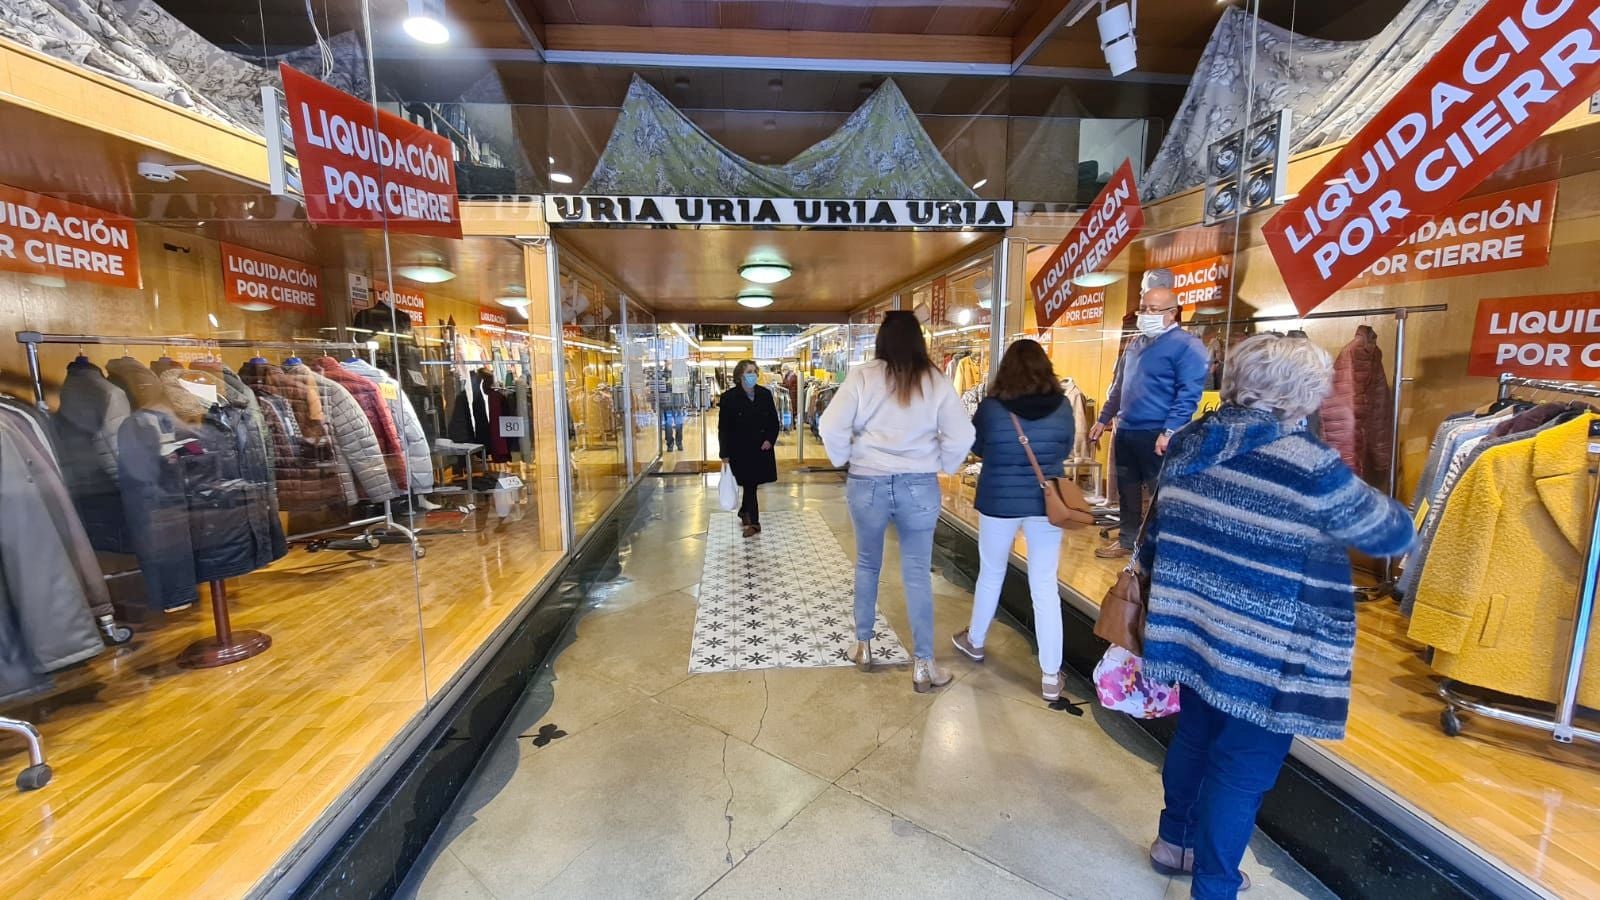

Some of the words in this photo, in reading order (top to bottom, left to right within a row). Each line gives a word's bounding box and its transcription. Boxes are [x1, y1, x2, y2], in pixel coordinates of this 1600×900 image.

[301, 102, 450, 185] LIQUIDACIÓN
[1313, 190, 1410, 280] POR
[1415, 5, 1600, 192] CIERR
[323, 165, 383, 212] POR
[385, 181, 451, 223] CIERRE
[553, 196, 664, 221] URIA
[675, 198, 780, 222] URIA
[794, 200, 897, 224] URIA
[906, 201, 1006, 224] URIA
[1036, 178, 1130, 301] LIQUIDACIÓN
[1396, 199, 1542, 247] IDACIÓN
[24, 239, 125, 276] CIERRE
[1045, 279, 1072, 320] POR
[1073, 212, 1130, 280] CIERRE
[1414, 234, 1525, 271] CIERRE
[228, 255, 318, 288] LIQUIDACIÓN
[1174, 262, 1229, 288] IDACIÓN
[236, 279, 269, 299] POR
[271, 286, 316, 306] CIERRE
[1177, 284, 1222, 306] CIERRE
[1495, 343, 1568, 366] POR
[505, 421, 520, 432] 80
